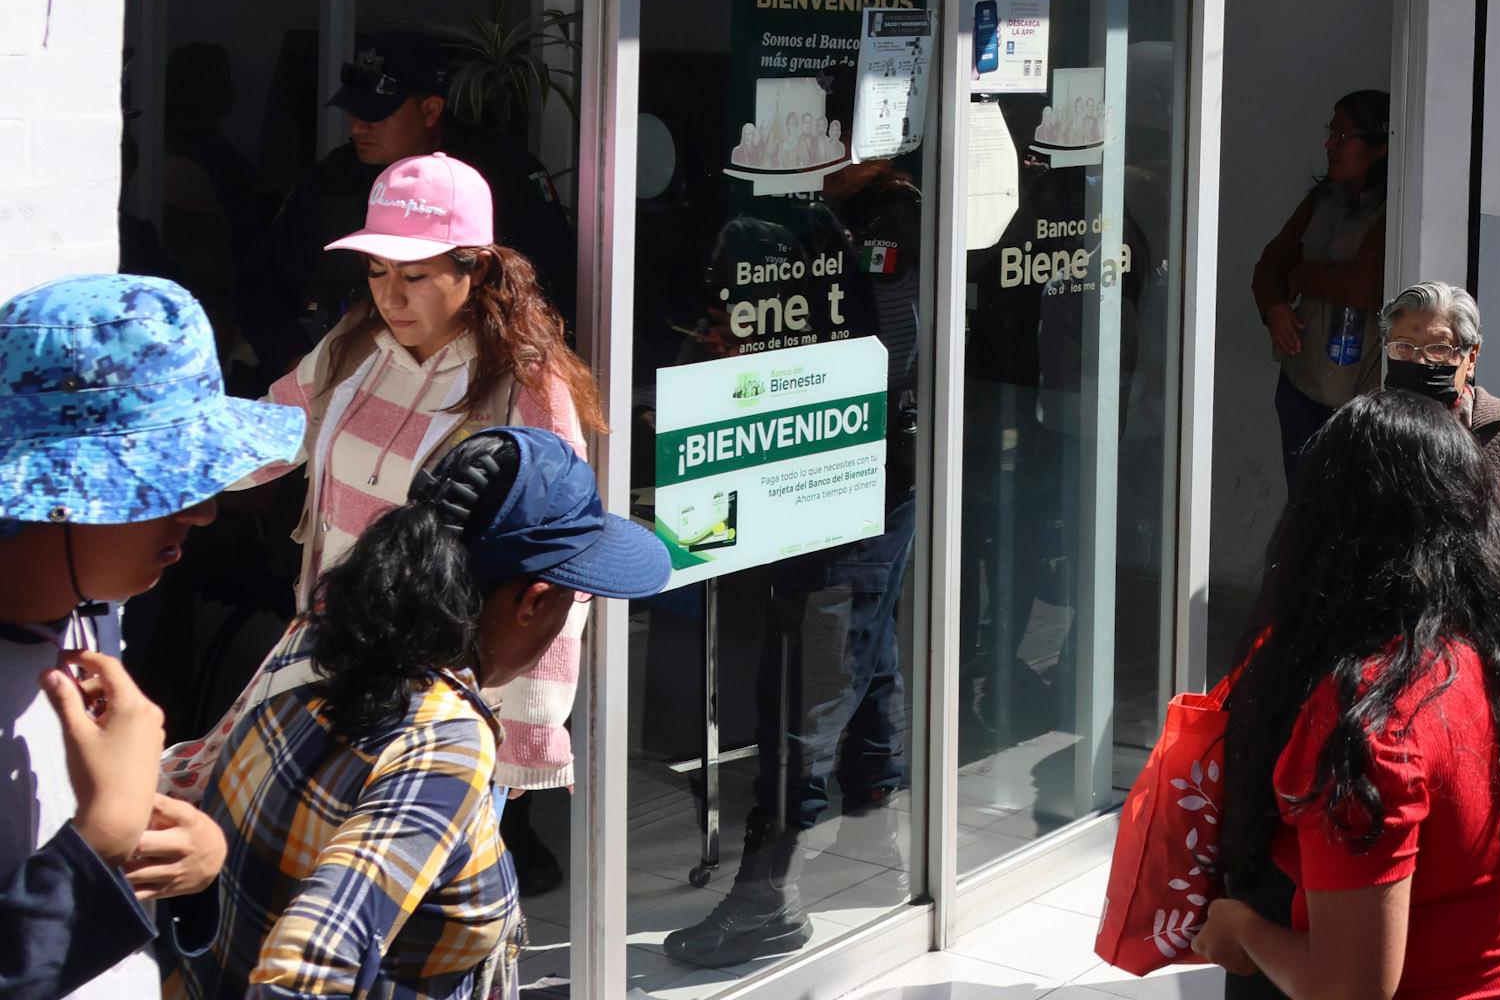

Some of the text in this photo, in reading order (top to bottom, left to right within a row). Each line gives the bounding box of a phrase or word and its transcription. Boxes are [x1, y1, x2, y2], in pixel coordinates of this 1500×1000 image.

[761, 31, 804, 49] Somos
[805, 33, 817, 49] el
[819, 34, 861, 51] Banco
[1012, 28, 1035, 36] LA APP!
[760, 52, 787, 69] más
[370, 183, 448, 217] Champion
[1036, 218, 1088, 240] Banco
[864, 239, 898, 249] MÉXICO
[736, 250, 844, 286] Banco del
[767, 338, 782, 350] de
[784, 335, 799, 349] los
[769, 371, 828, 393] Bienestar
[770, 365, 804, 378] Banco del
[677, 402, 870, 477] ¡BIENVENIDO!
[760, 454, 878, 487] Paga todo lo que necesites con tu
[768, 466, 878, 498] tarjeta del Banco del Bienestar
[794, 478, 878, 506] ¡Ahorra tiempo y dinero!
